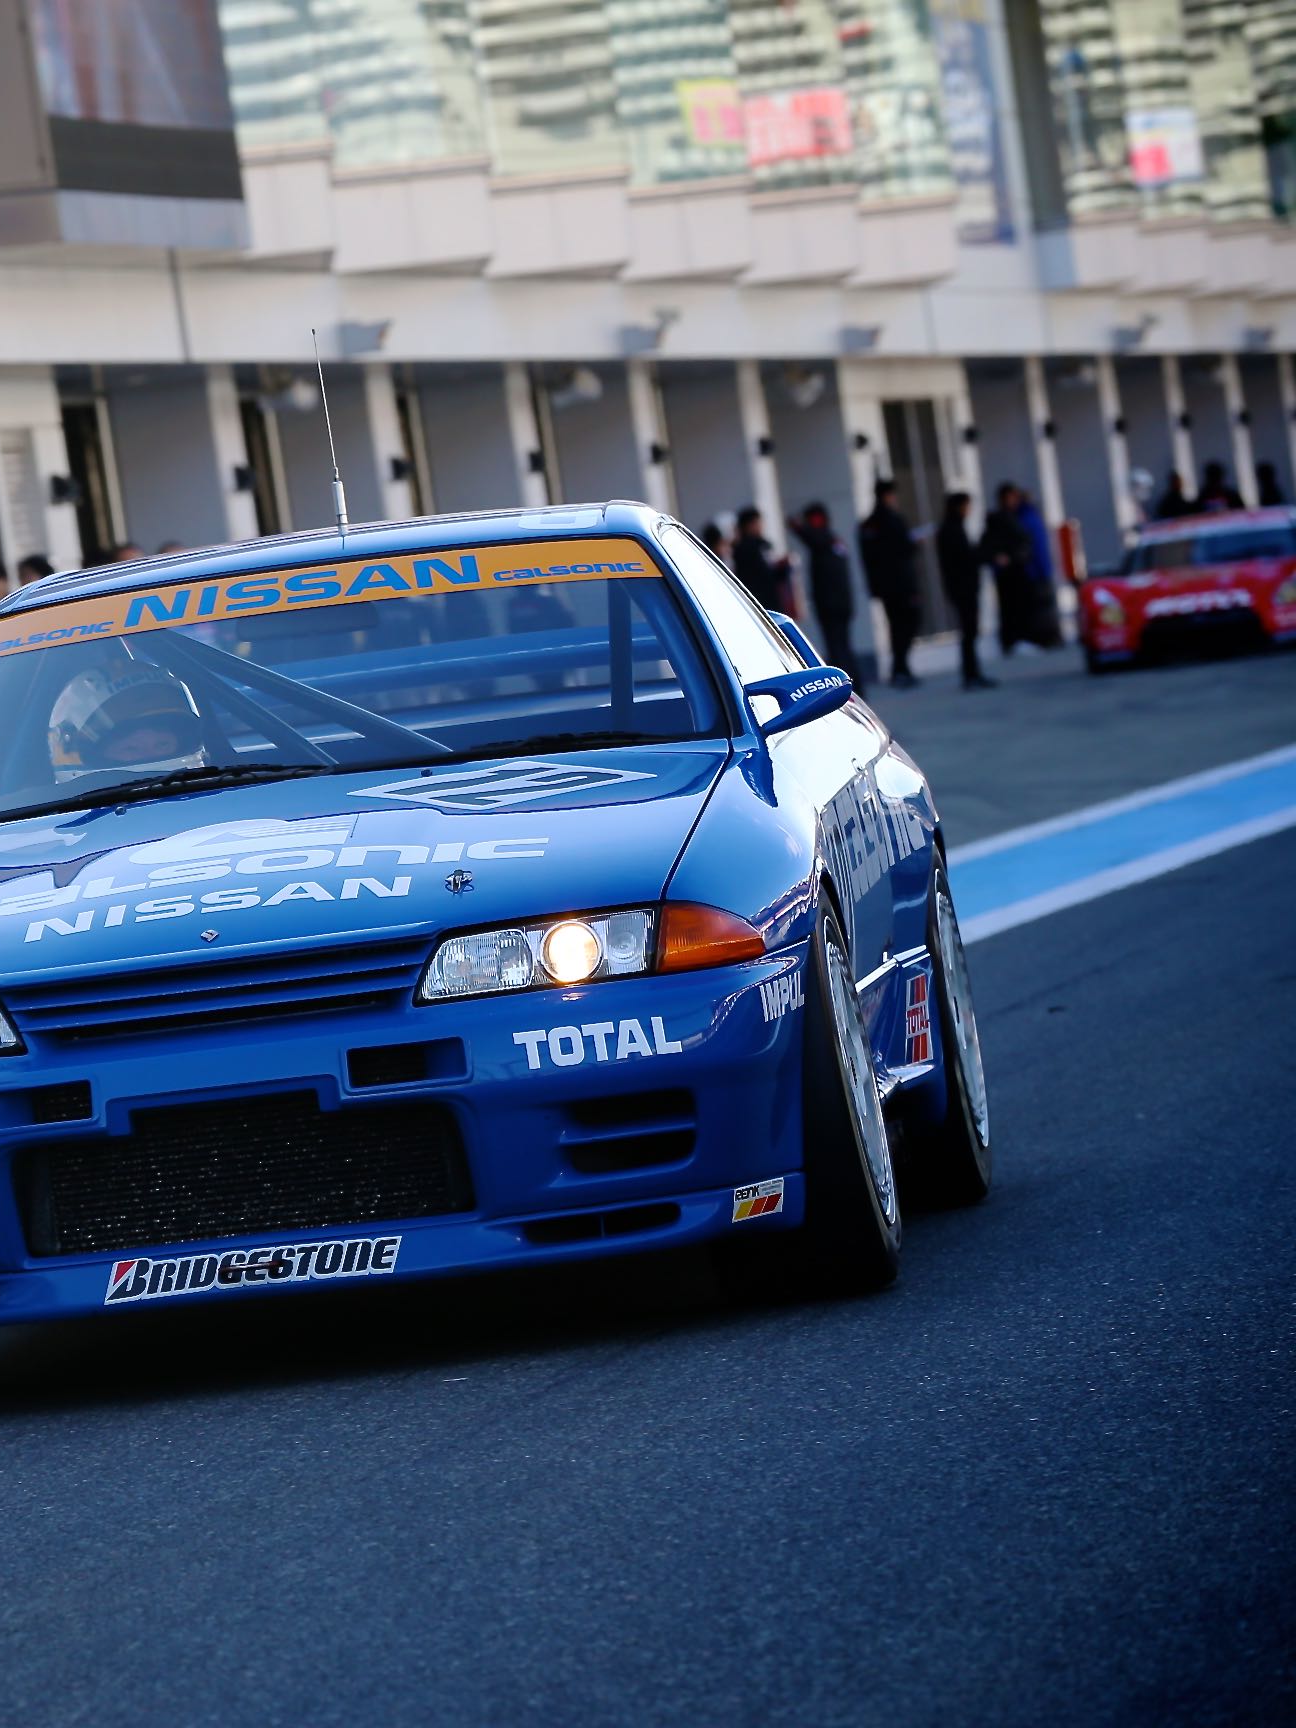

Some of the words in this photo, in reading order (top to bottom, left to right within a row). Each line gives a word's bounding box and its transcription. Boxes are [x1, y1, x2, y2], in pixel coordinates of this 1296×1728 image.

[124, 555, 480, 628] NISSAN
[790, 675, 843, 702] NISSAN
[24, 875, 412, 943] NISSAN
[759, 971, 804, 1022] IMPUL
[906, 1004, 929, 1034] TOTAL
[513, 1016, 682, 1070] TOTAL
[108, 1238, 399, 1301] BRIDGESTONE
